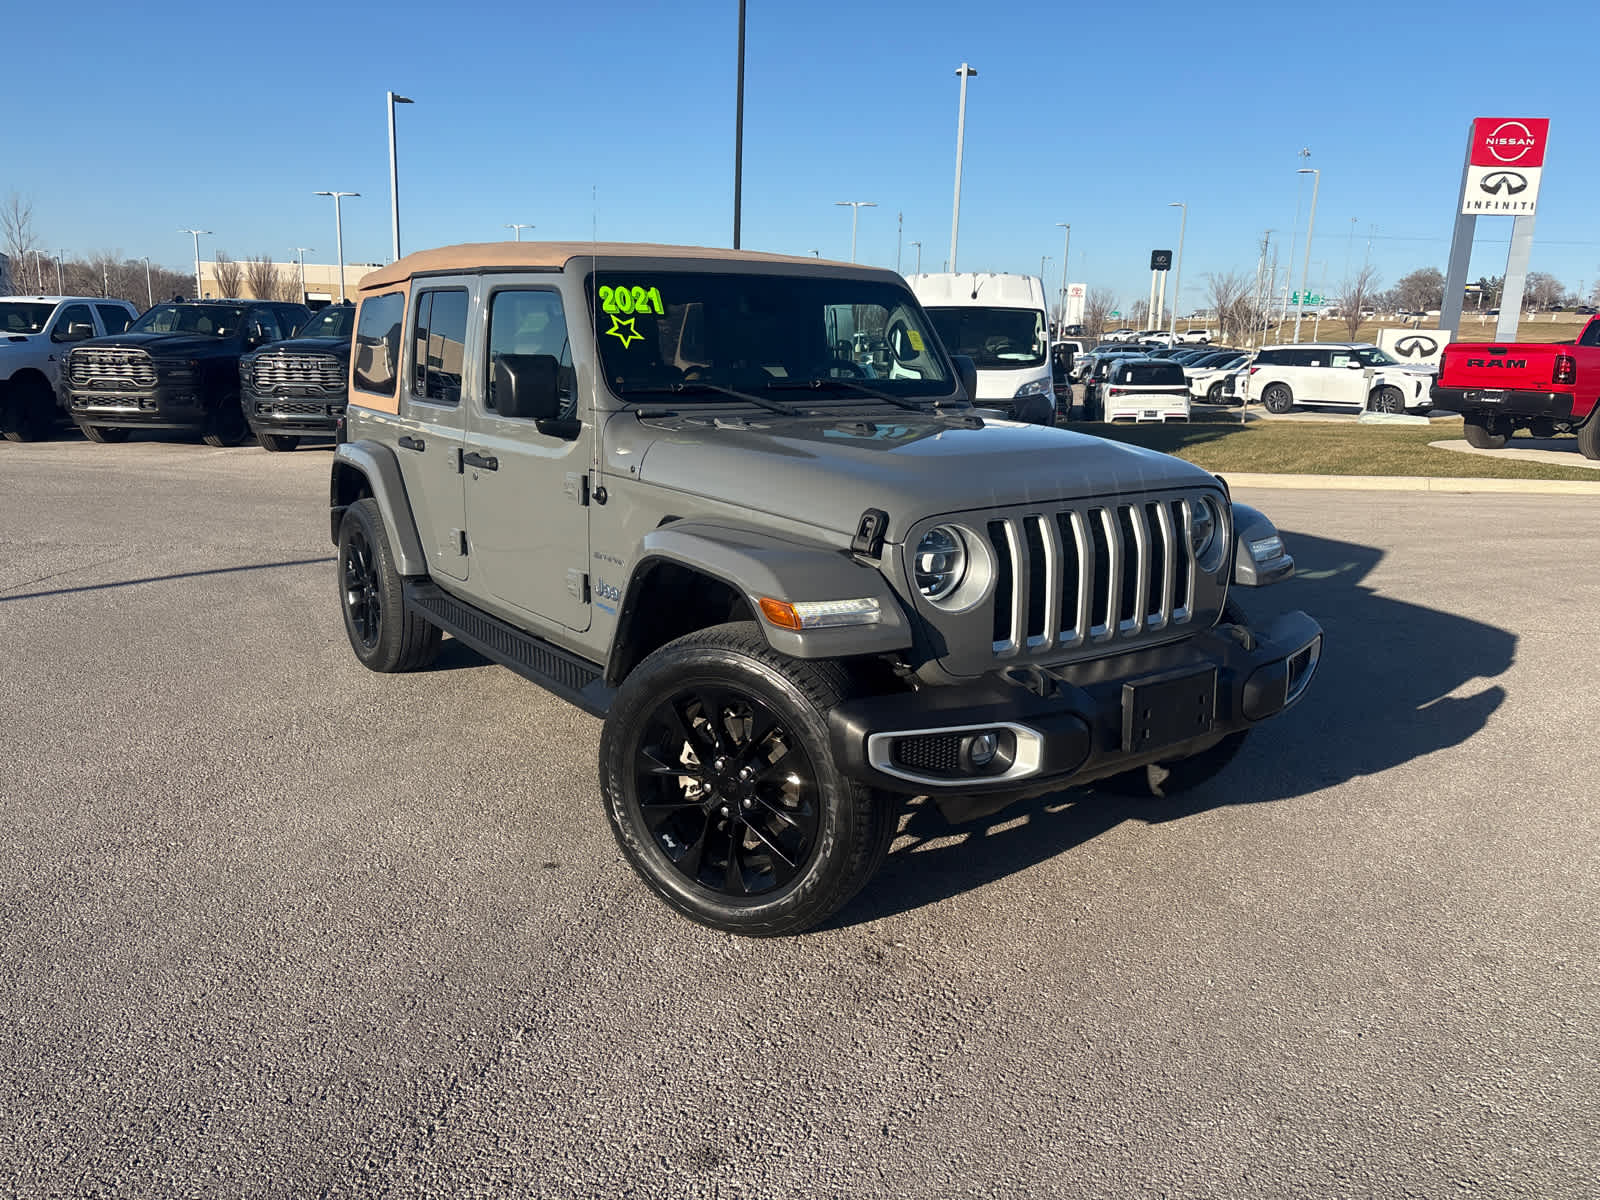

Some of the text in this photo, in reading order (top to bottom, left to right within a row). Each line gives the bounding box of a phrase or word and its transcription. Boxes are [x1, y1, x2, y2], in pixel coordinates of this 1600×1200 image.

[1466, 200, 1534, 211] INFINITI
[599, 285, 665, 315] 2021
[1466, 359, 1527, 369] RAM
